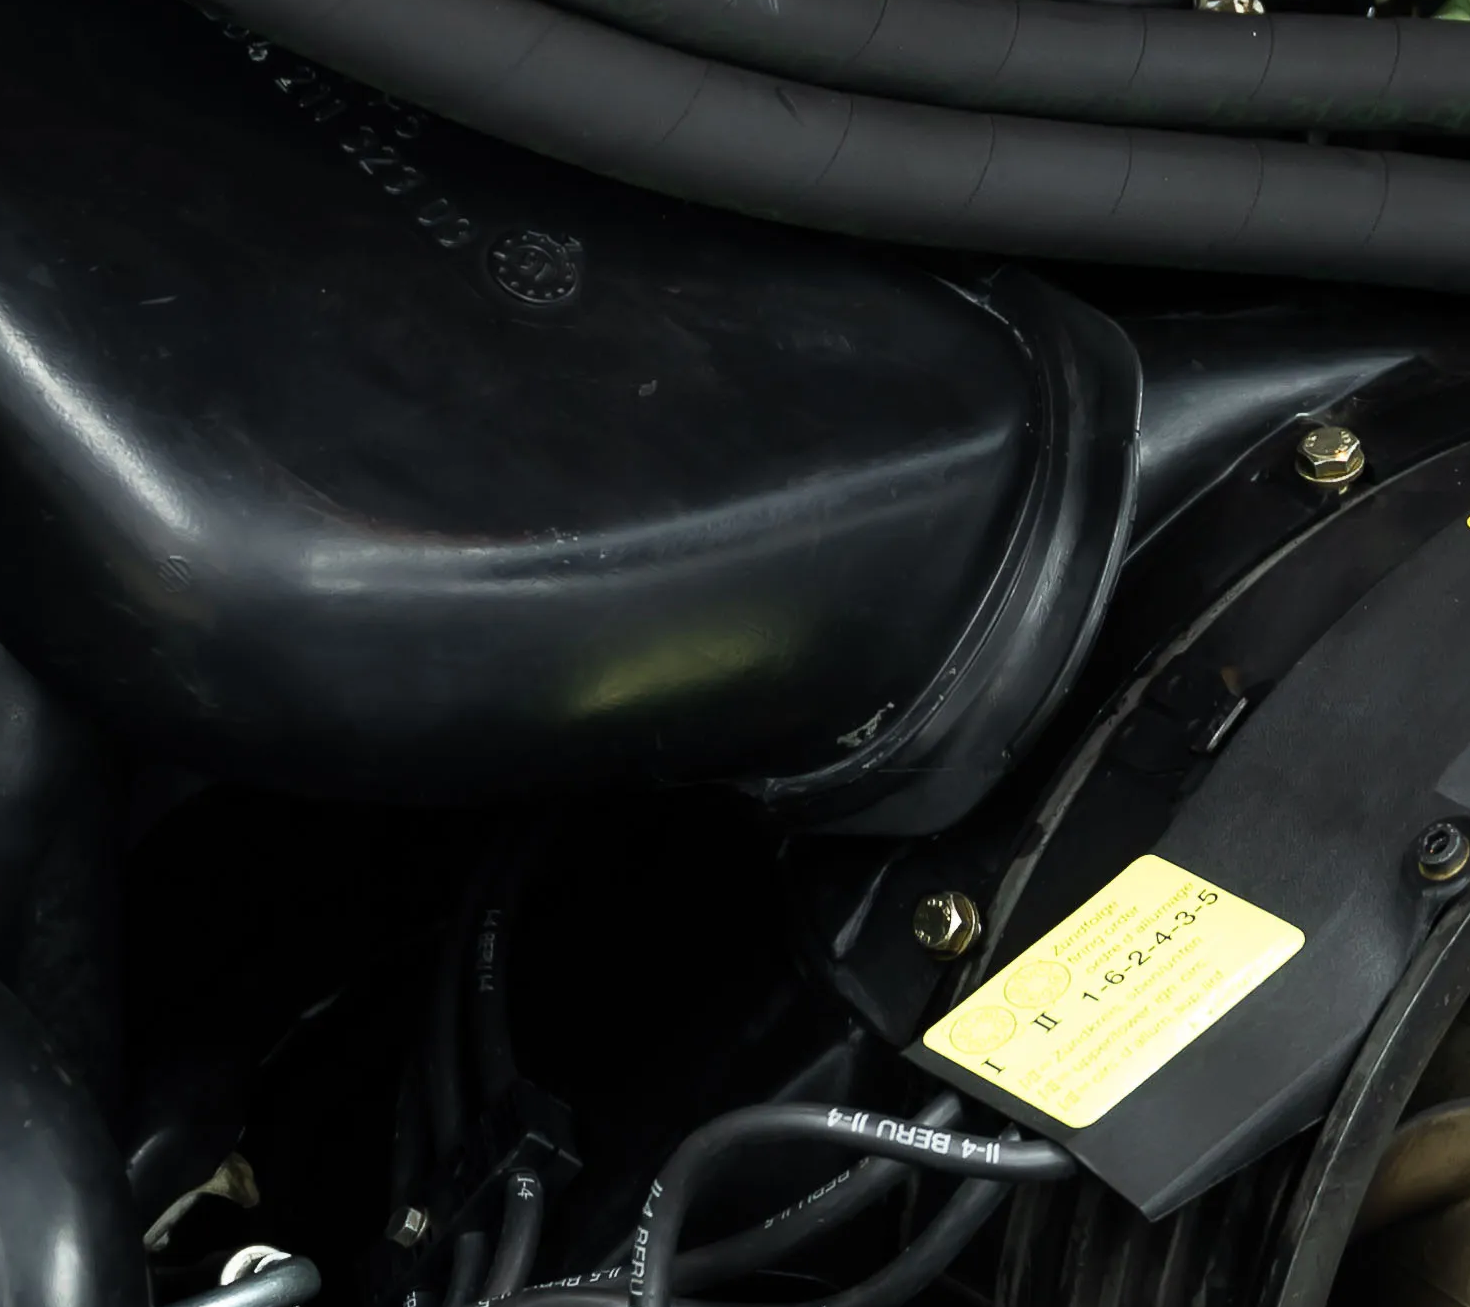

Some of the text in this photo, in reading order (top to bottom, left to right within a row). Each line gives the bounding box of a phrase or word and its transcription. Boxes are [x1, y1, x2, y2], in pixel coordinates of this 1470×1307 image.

[1081, 888, 1219, 1002] 1-6-2-4-3-5
[827, 1107, 1001, 1165] II-4 BERU II-4
[629, 1224, 650, 1297] BERU
